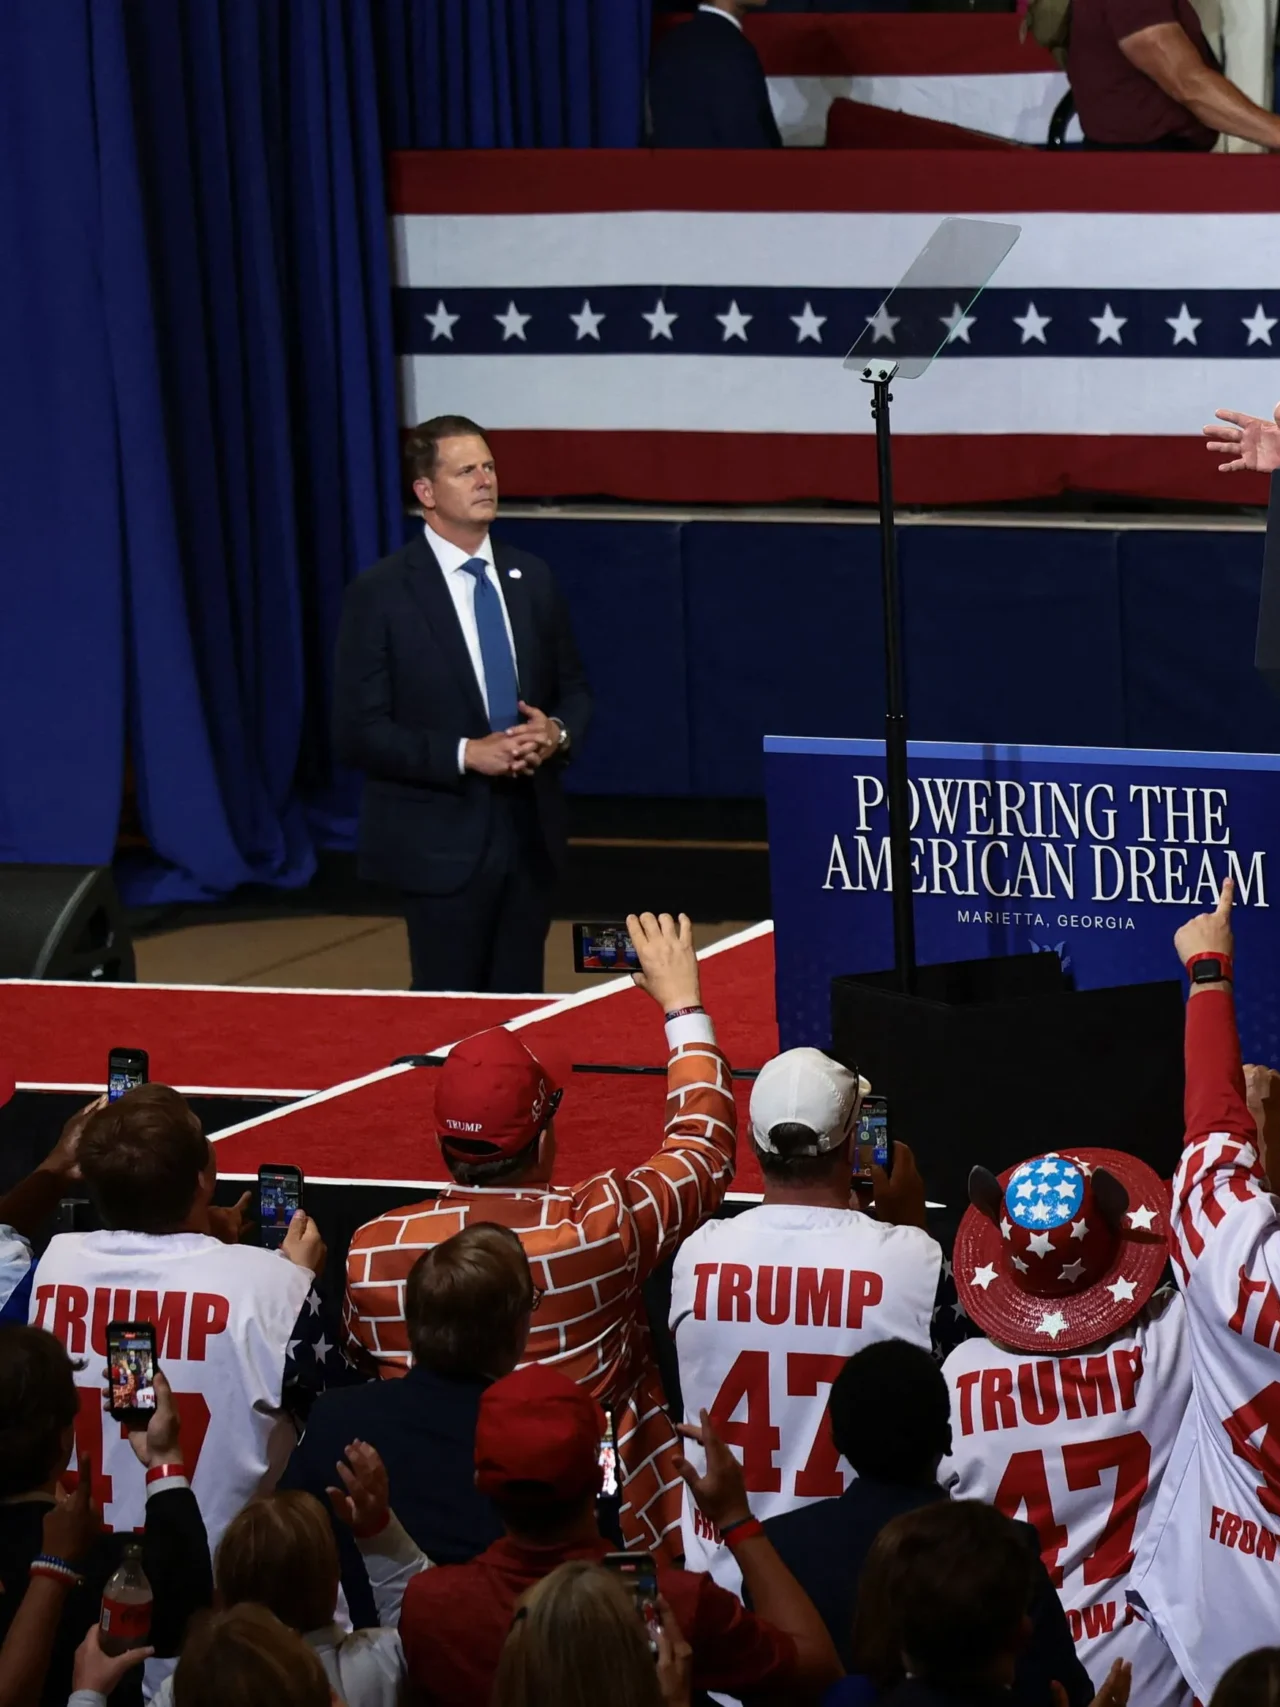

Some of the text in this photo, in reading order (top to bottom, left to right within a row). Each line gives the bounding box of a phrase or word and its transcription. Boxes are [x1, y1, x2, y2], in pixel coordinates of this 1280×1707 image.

[1129, 784, 1231, 846] THE
[1091, 844, 1270, 909] DREAM
[956, 909, 1136, 932] MARIETTA, GEORGIA
[446, 1119, 483, 1133] TRUMP
[34, 1284, 230, 1362] TRUMP
[693, 1262, 884, 1330] TRUMP
[705, 1349, 855, 1498] 47
[956, 1346, 1145, 1437] TRUMP
[993, 1430, 1152, 1590] 47
[1065, 1600, 1117, 1643] OW
